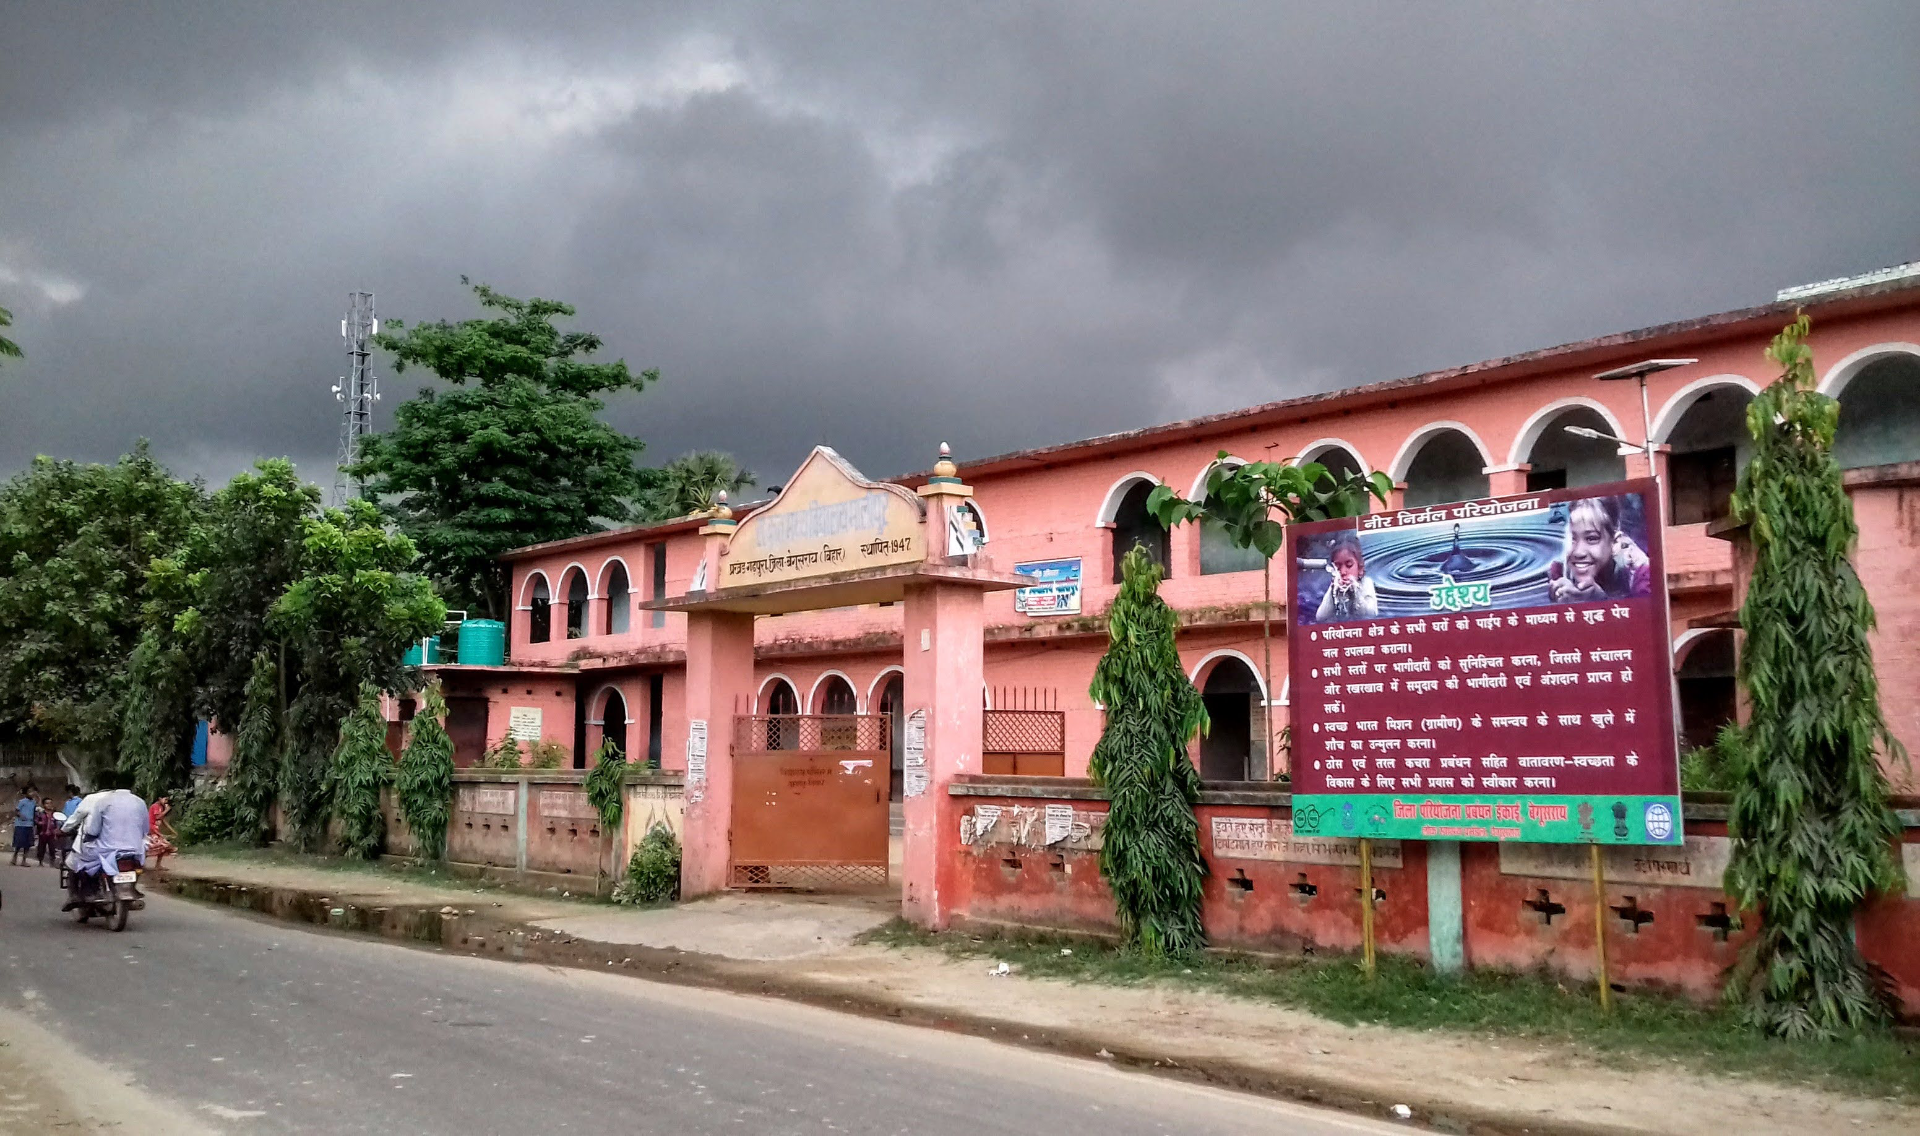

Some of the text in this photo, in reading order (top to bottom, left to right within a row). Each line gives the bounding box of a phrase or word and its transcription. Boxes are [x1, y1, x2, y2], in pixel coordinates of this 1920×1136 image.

[1363, 497, 1541, 530] नीर निर्मल परियोजना
[1431, 575, 1490, 610] उद्देश्य
[1322, 604, 1630, 641] परियोजना क्षेत्र के सभी घरों को पाईप के माध्यम से शुद्ध पेय
[1322, 648, 1338, 658] जल
[1323, 662, 1342, 677] सभी
[1347, 661, 1368, 676] स्तरों
[1374, 662, 1387, 674] पर
[1393, 657, 1431, 673] भागीदारी
[1437, 656, 1451, 671] को
[1459, 654, 1503, 673] सुनिश्चित
[1549, 648, 1582, 665] जिससे
[1590, 647, 1632, 662] संचालन
[1346, 682, 1384, 695] रखरखाव
[1390, 678, 1400, 692] में
[1406, 680, 1439, 695] समुदाय
[1445, 675, 1459, 690] की
[1466, 673, 1507, 689] भागीदारी
[1514, 672, 1532, 689] एवं
[1540, 671, 1579, 686] अंशदान
[1586, 670, 1613, 684] प्राप्त
[1620, 666, 1633, 683] हो
[1324, 708, 1637, 733] स्वच्छ भारत मिशन (ग्रामीण) के समन्वय के साथ खुले में
[1350, 740, 1363, 750] का
[1325, 756, 1343, 770] ठोस
[1351, 756, 1366, 771] एवं
[1375, 758, 1396, 769] तरल
[1404, 758, 1431, 769] कचरा
[1440, 754, 1472, 769] प्रबंधन
[1481, 753, 1508, 768] सहित
[1625, 750, 1639, 767] के
[1326, 774, 1355, 788] विकास
[1360, 773, 1371, 788] के
[1376, 774, 1396, 790] लिए
[1401, 773, 1421, 788] सभी
[1427, 777, 1455, 788] प्रयास
[1460, 773, 1475, 788] को
[1481, 773, 1518, 788] स्वीकार
[1393, 799, 1417, 819] जिला
[1420, 799, 1461, 820] परियोजना
